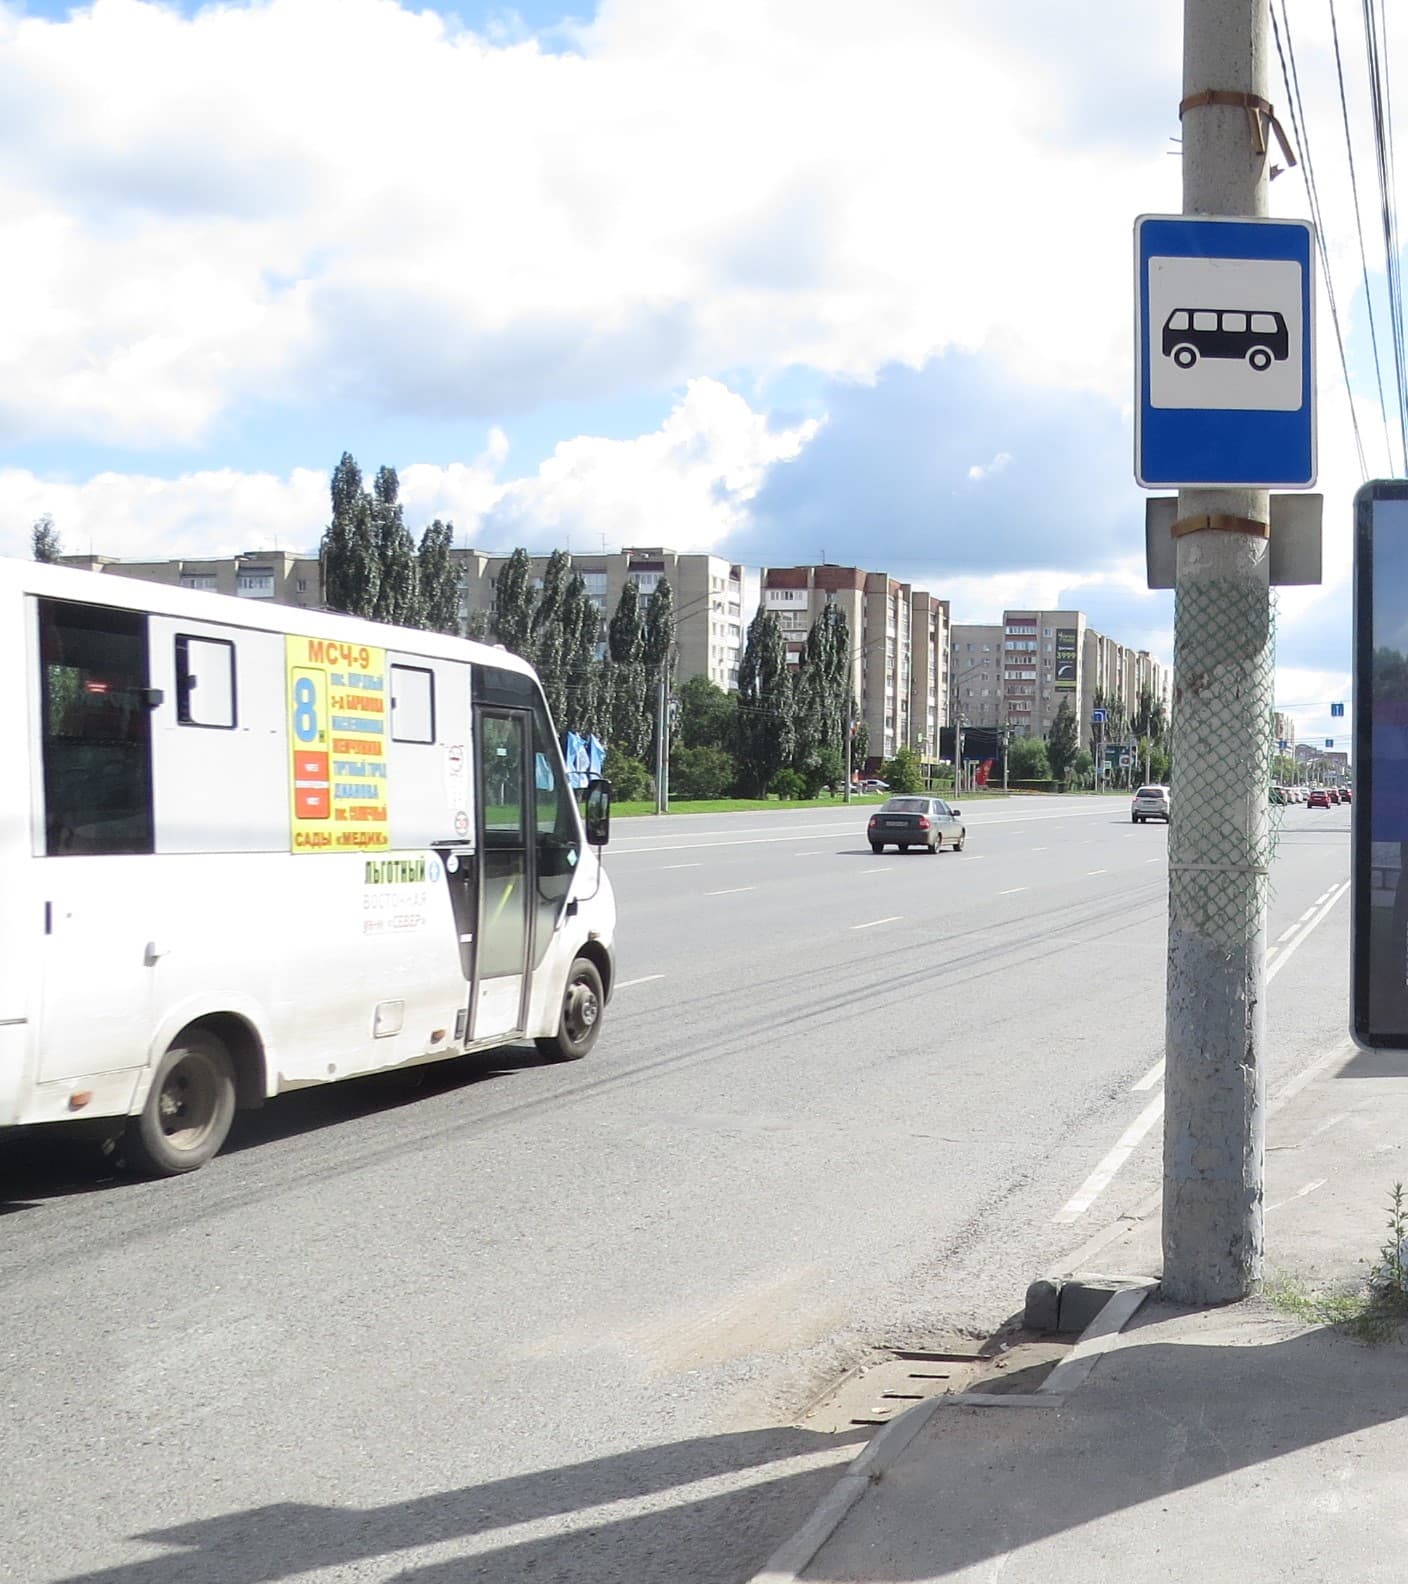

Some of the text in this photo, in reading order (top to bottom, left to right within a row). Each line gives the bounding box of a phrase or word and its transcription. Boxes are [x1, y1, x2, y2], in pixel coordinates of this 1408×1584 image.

[308, 640, 369, 669] МСЧ-9
[295, 832, 332, 848] САДЫ
[365, 856, 426, 884] ЛЬГОТНЫЙ
